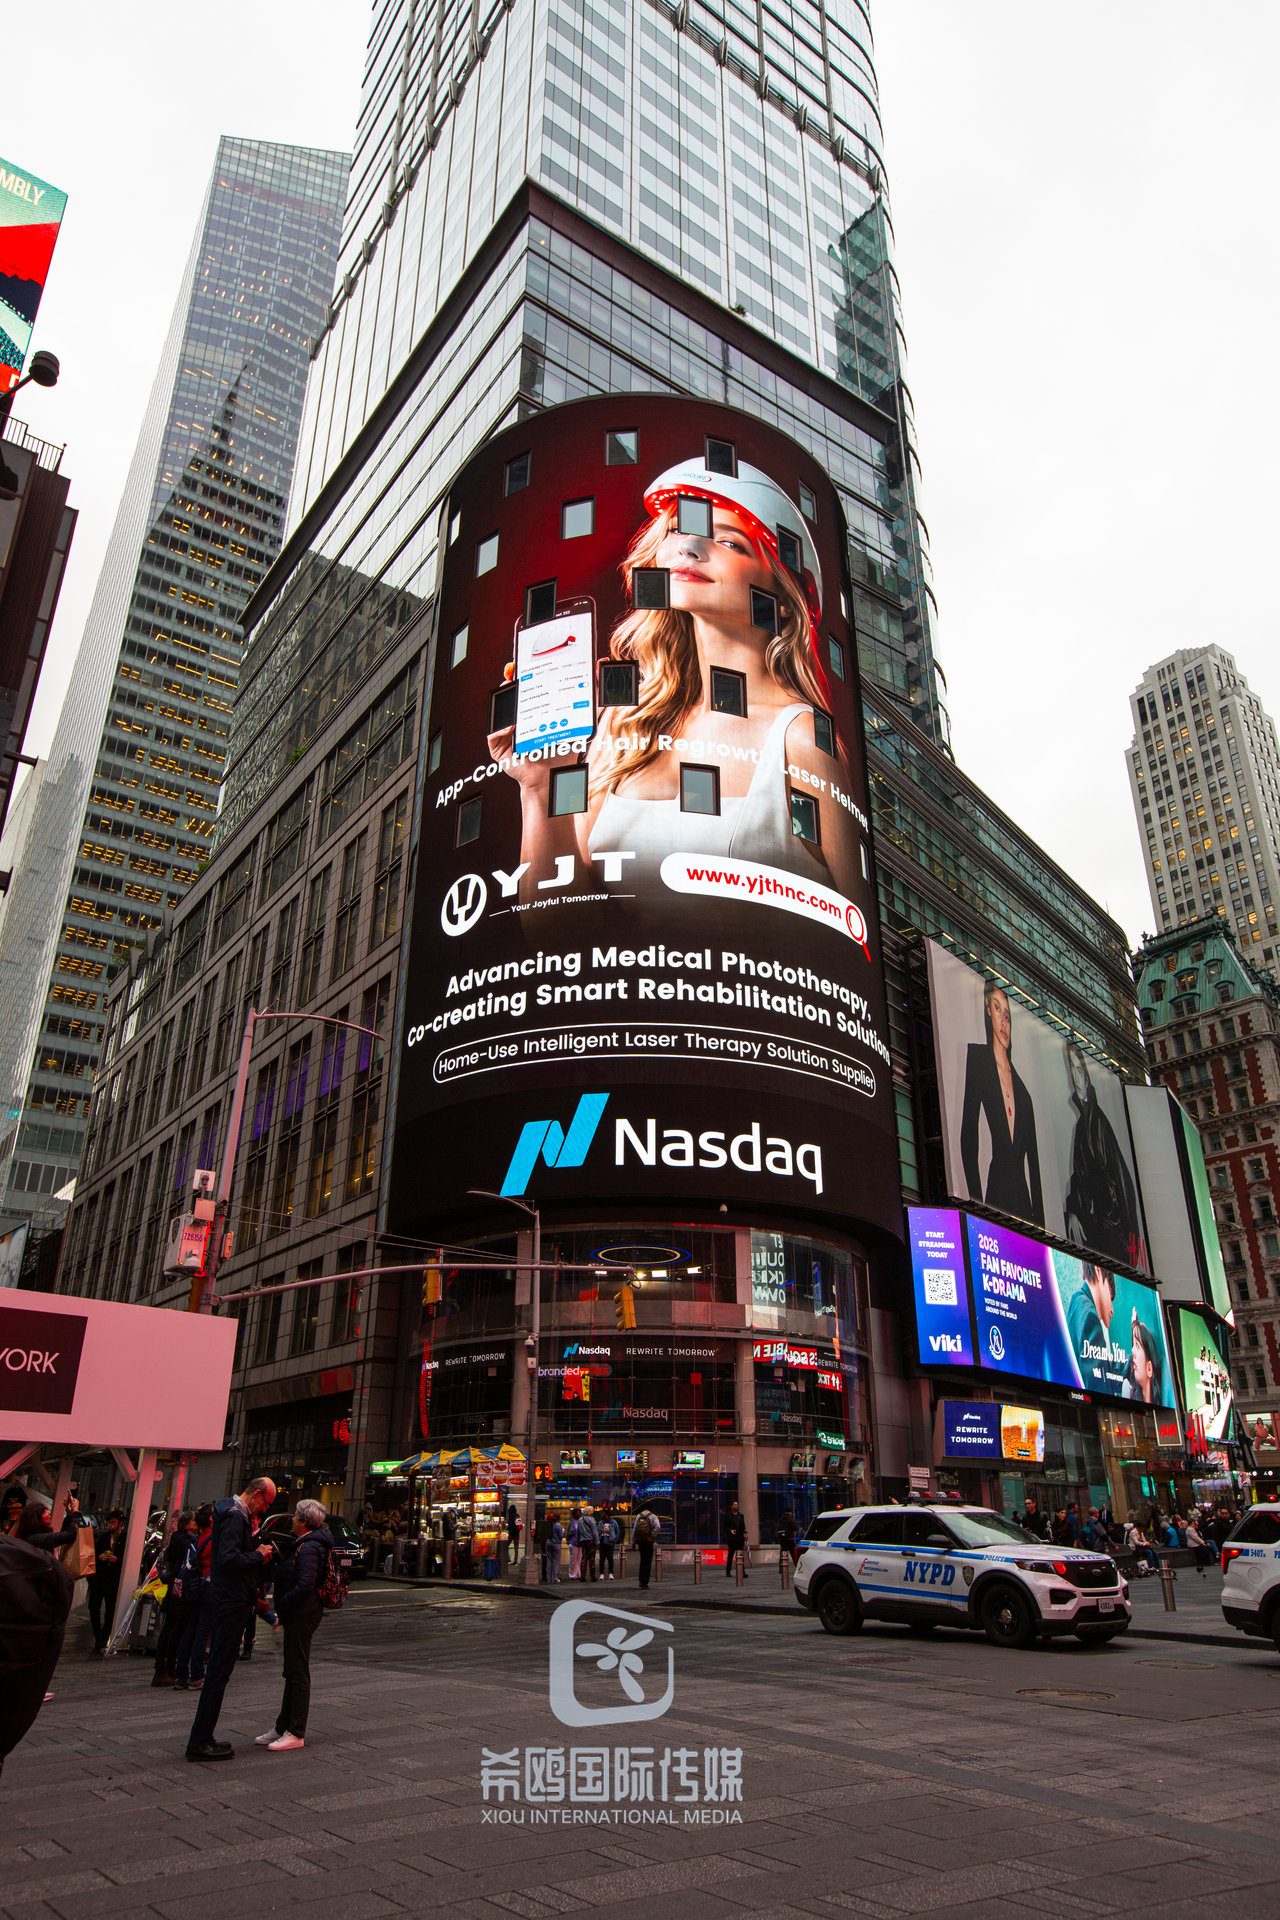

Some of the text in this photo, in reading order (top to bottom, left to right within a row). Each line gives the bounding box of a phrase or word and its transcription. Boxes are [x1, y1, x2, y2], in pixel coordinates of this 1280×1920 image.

[435, 738, 587, 808] App-Controlled
[597, 733, 650, 750] Hair
[780, 757, 827, 792] Laser
[830, 782, 869, 833] Helmet
[491, 851, 636, 898] YJT
[511, 893, 609, 913] Your Joyful Tomorrow
[686, 866, 843, 920] www.yjthnc.com
[445, 945, 872, 1022] Advancing Medical Phototherapy,
[407, 978, 891, 1067] Co-creating Smart Rehabilitation Solutions
[438, 1031, 874, 1090] Home-Use Intelligent Laser Therapy Solution Supplier
[614, 1117, 824, 1195] Nasdaq
[918, 1240, 955, 1249] STREAMING
[925, 1231, 945, 1239] START
[978, 1233, 999, 1254] 2026
[926, 1251, 948, 1259] TODAY
[980, 1252, 1043, 1289] FAN FAVORITE
[982, 1273, 1027, 1304] K-DRAMA
[578, 1345, 611, 1356] Nasdaq
[626, 1347, 716, 1357] REWRITE TOMORROW
[929, 1333, 963, 1352] Viki
[1080, 1339, 1108, 1361] Dream
[1112, 1342, 1128, 1363] You
[445, 1352, 505, 1366] REWRITE TOMORROW
[818, 1358, 839, 1369] REWRITE
[623, 1406, 669, 1421] Nasdaq
[950, 1436, 994, 1444] TOMORROW
[956, 1426, 988, 1434] REWRITE
[983, 1554, 1006, 1563] POLICE
[903, 1560, 956, 1586] NYPD
